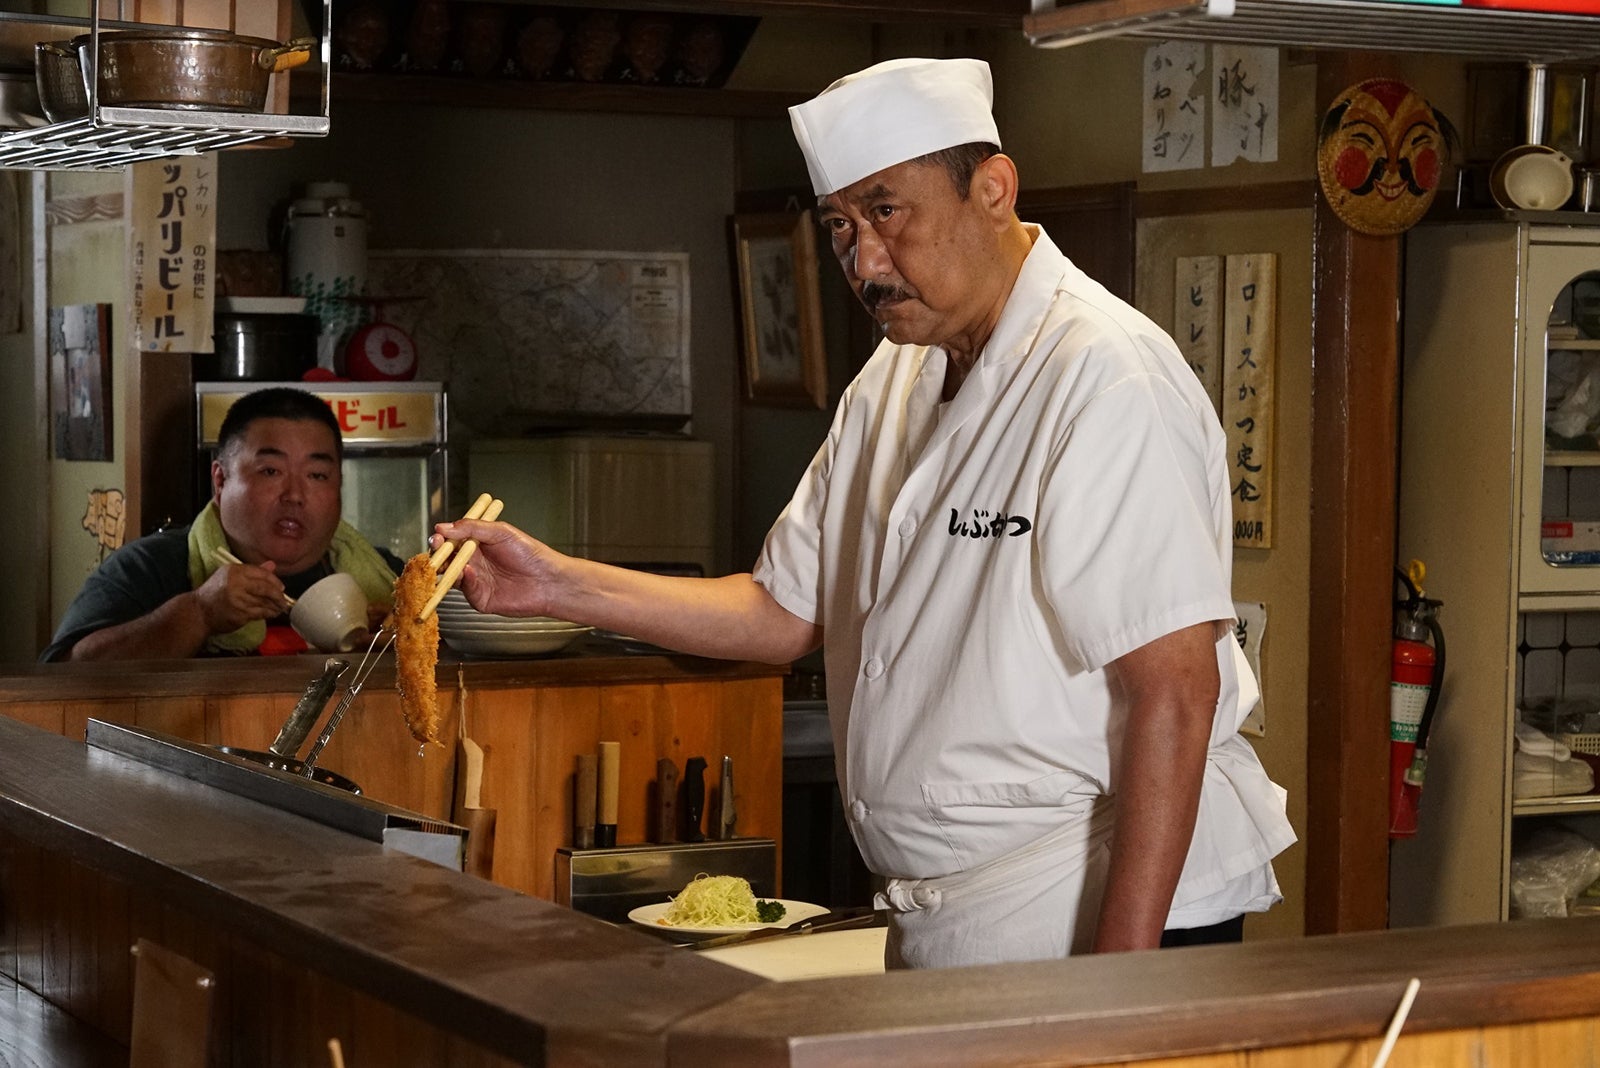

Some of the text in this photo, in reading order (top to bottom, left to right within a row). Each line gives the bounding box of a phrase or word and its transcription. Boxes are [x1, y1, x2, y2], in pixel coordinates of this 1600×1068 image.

[1152, 40, 1173, 158] かわり可
[1219, 59, 1268, 158] 豚汁
[155, 155, 187, 339] ッパリビール
[193, 155, 209, 300] レカツ のお供に
[1231, 283, 1262, 502] ロースかつ定食
